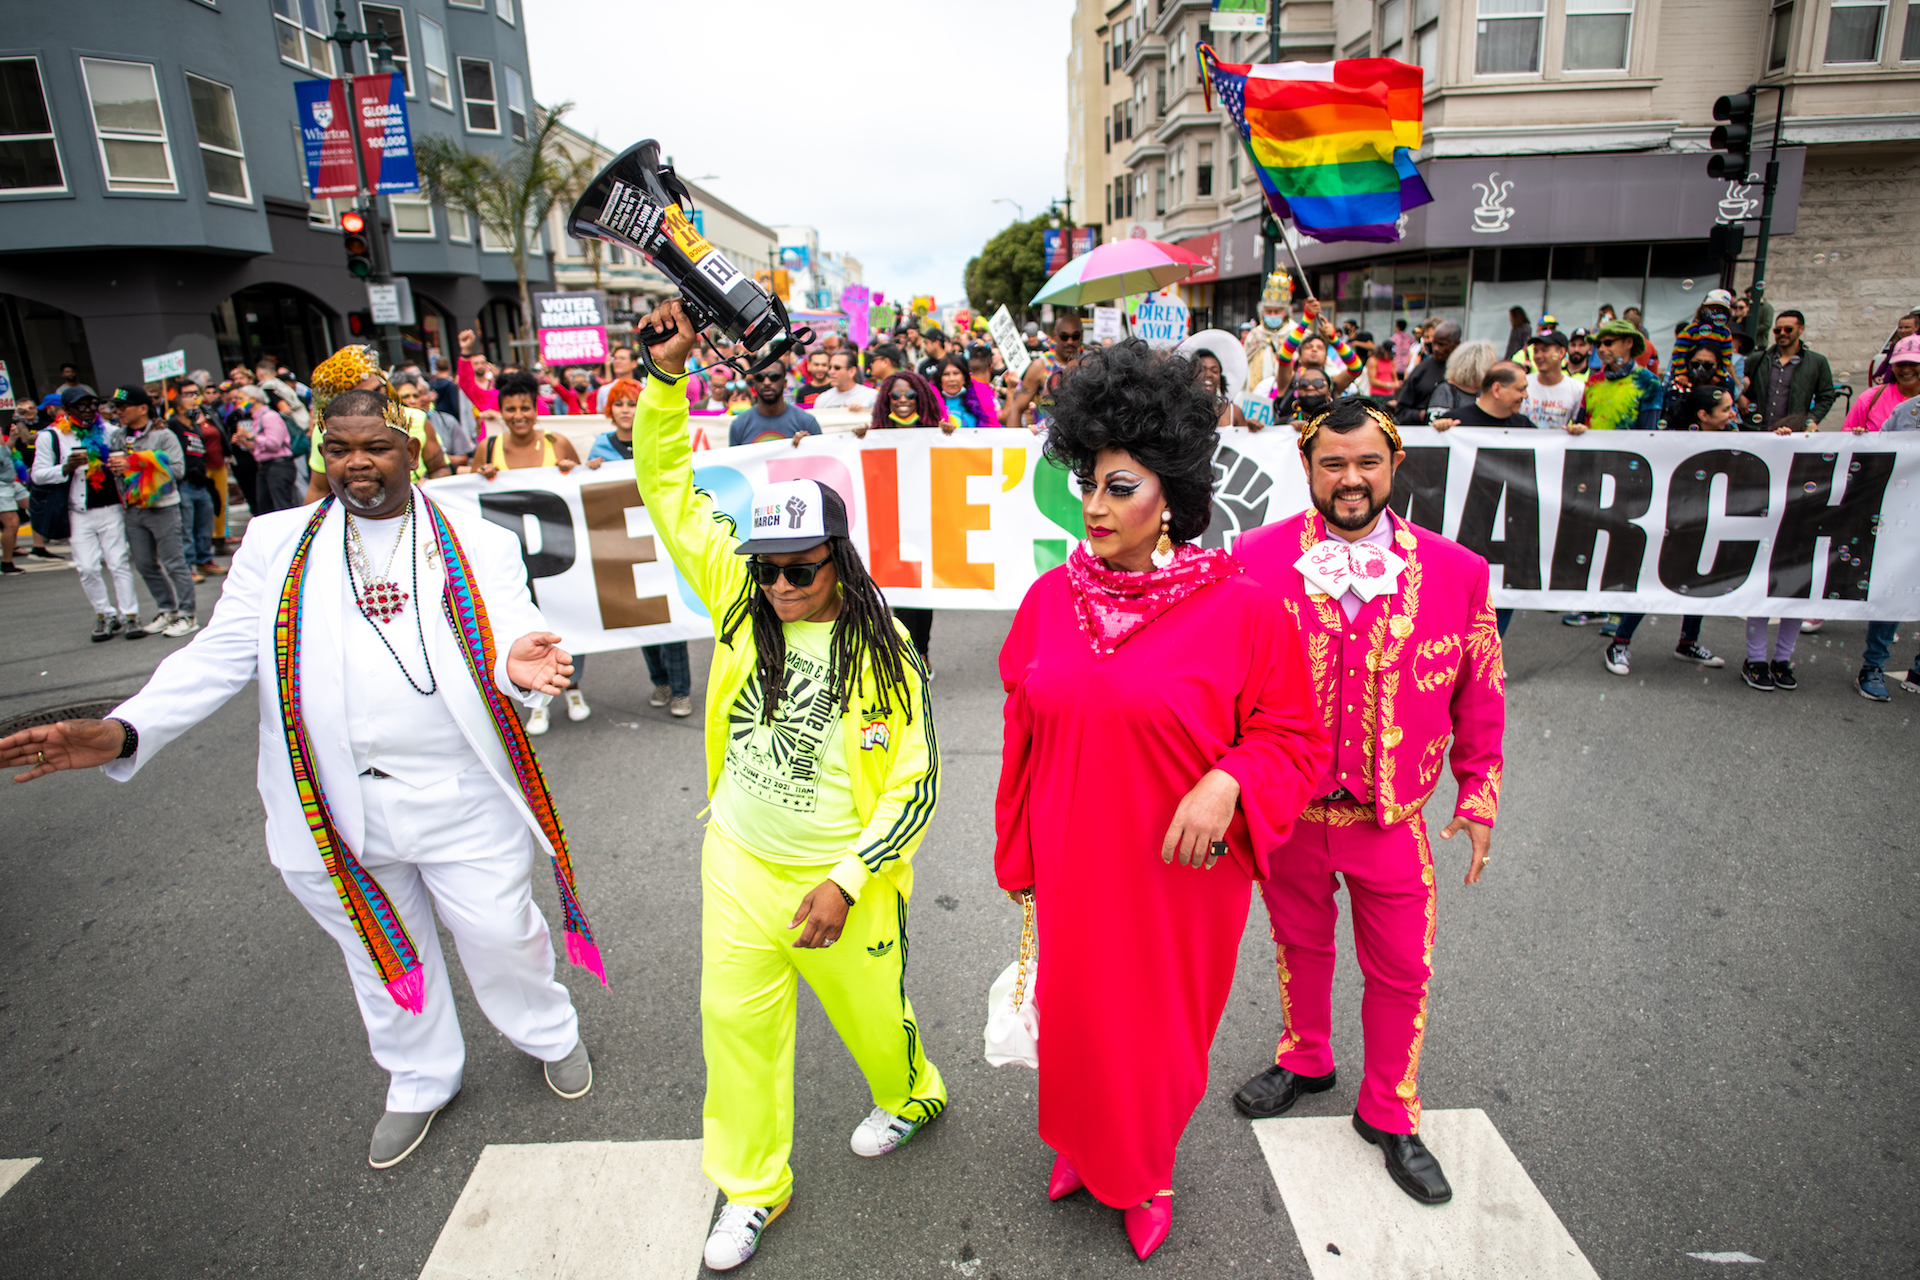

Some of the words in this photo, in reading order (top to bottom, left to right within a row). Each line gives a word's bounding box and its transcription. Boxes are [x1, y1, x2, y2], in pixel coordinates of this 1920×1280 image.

[362, 104, 402, 117] GLOBAL
[363, 116, 404, 128] NETWORK
[304, 128, 349, 140] Wharton
[367, 136, 407, 148] 100,000
[383, 147, 408, 157] ALUMNI
[637, 203, 653, 228] MUST
[629, 225, 643, 241] GO!
[680, 226, 704, 247] UT
[688, 244, 710, 258] Pence
[541, 297, 596, 313] VOTER
[541, 311, 601, 327] RIGHTS
[545, 329, 600, 346] QUEER
[545, 343, 604, 360] RIGHTS
[753, 515, 781, 528] MARCH
[785, 650, 814, 675] March
[742, 765, 759, 779] JUNE
[774, 781, 790, 791] 2021
[795, 786, 815, 795] 11AM
